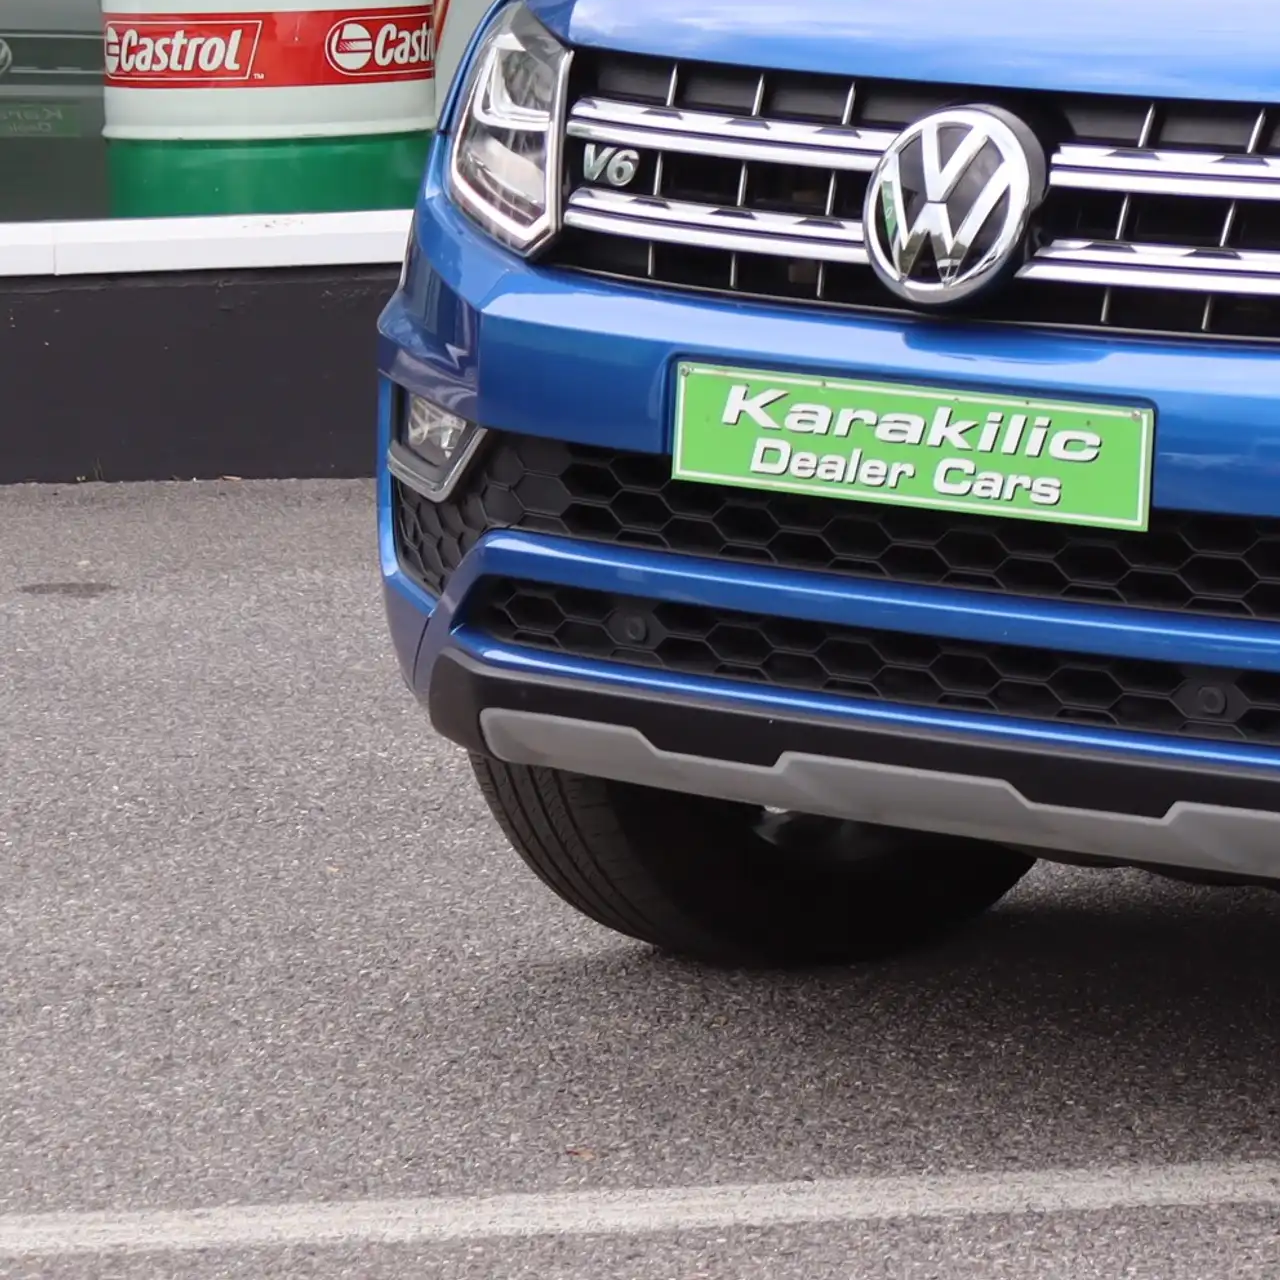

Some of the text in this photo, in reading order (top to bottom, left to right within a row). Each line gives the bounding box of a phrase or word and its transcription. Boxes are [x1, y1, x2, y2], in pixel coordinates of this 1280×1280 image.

[119, 27, 243, 74] Castrol
[581, 142, 640, 189] V6
[720, 383, 1104, 463] Karakilic
[750, 437, 1063, 507] Dealer Cars
